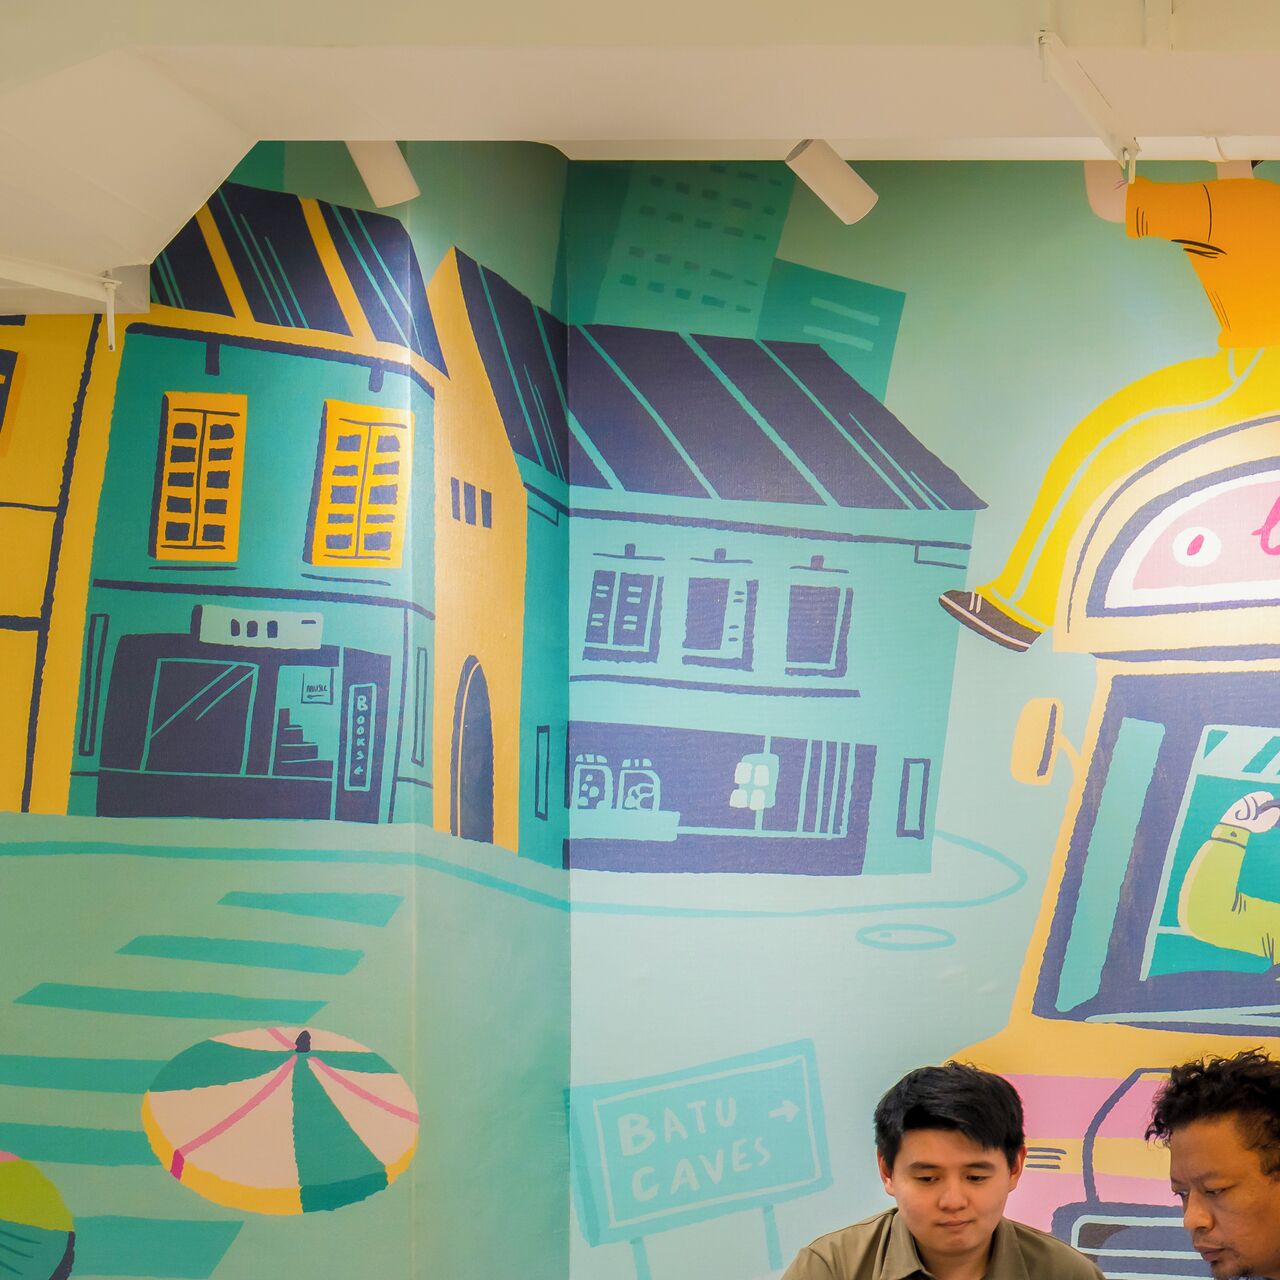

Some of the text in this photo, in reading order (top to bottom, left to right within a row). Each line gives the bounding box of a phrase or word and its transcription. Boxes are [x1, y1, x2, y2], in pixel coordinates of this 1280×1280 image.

[356, 695, 369, 760] BOOKS
[617, 1097, 736, 1157] BATU
[631, 1136, 771, 1202] CAVES
